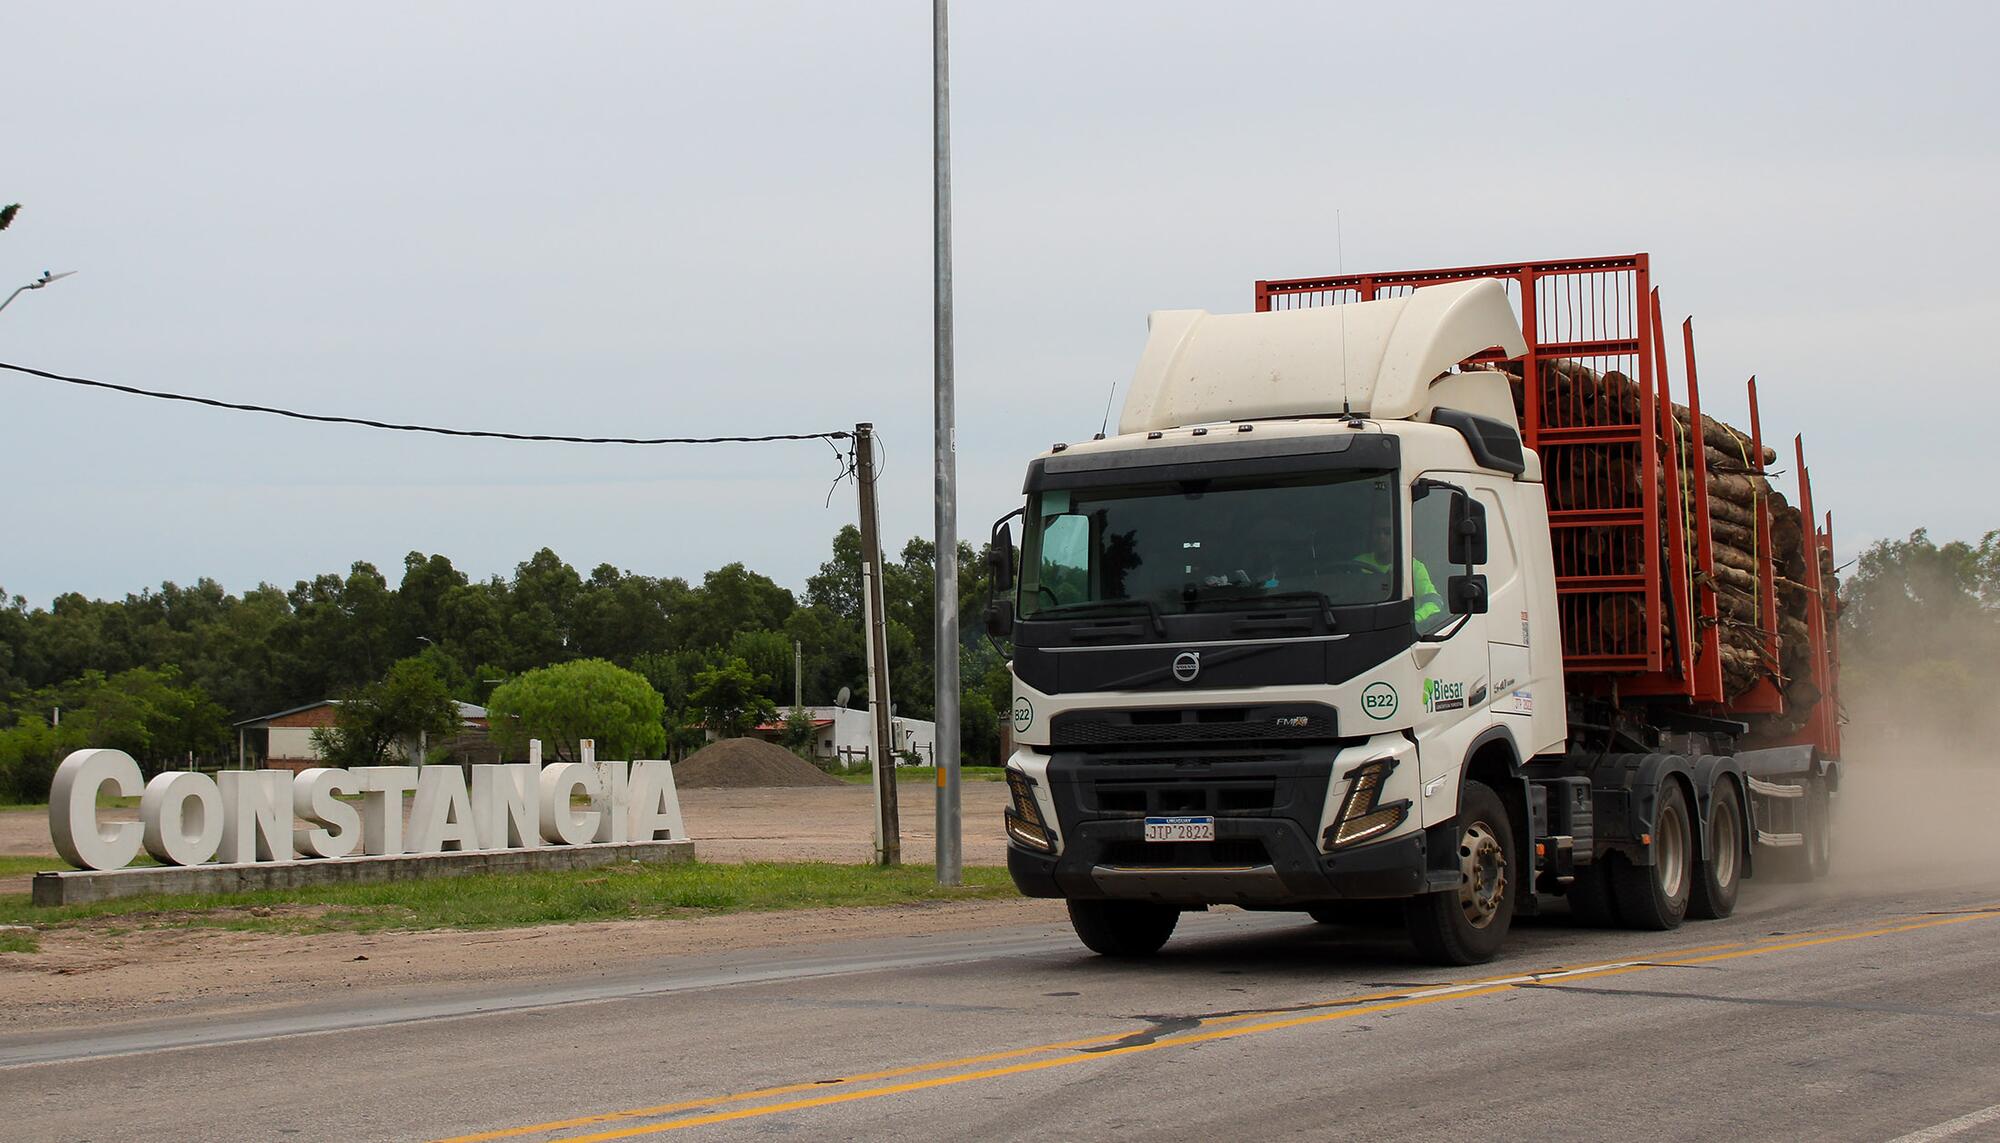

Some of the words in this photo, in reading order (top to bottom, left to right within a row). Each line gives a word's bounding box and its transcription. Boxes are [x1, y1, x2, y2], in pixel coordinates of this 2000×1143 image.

[1433, 679, 1463, 700] Biesar
[1366, 694, 1393, 708] B22
[49, 748, 685, 870] CONSTANCIA
[1149, 825, 1172, 839] JTP
[1178, 825, 1209, 839] 2822
